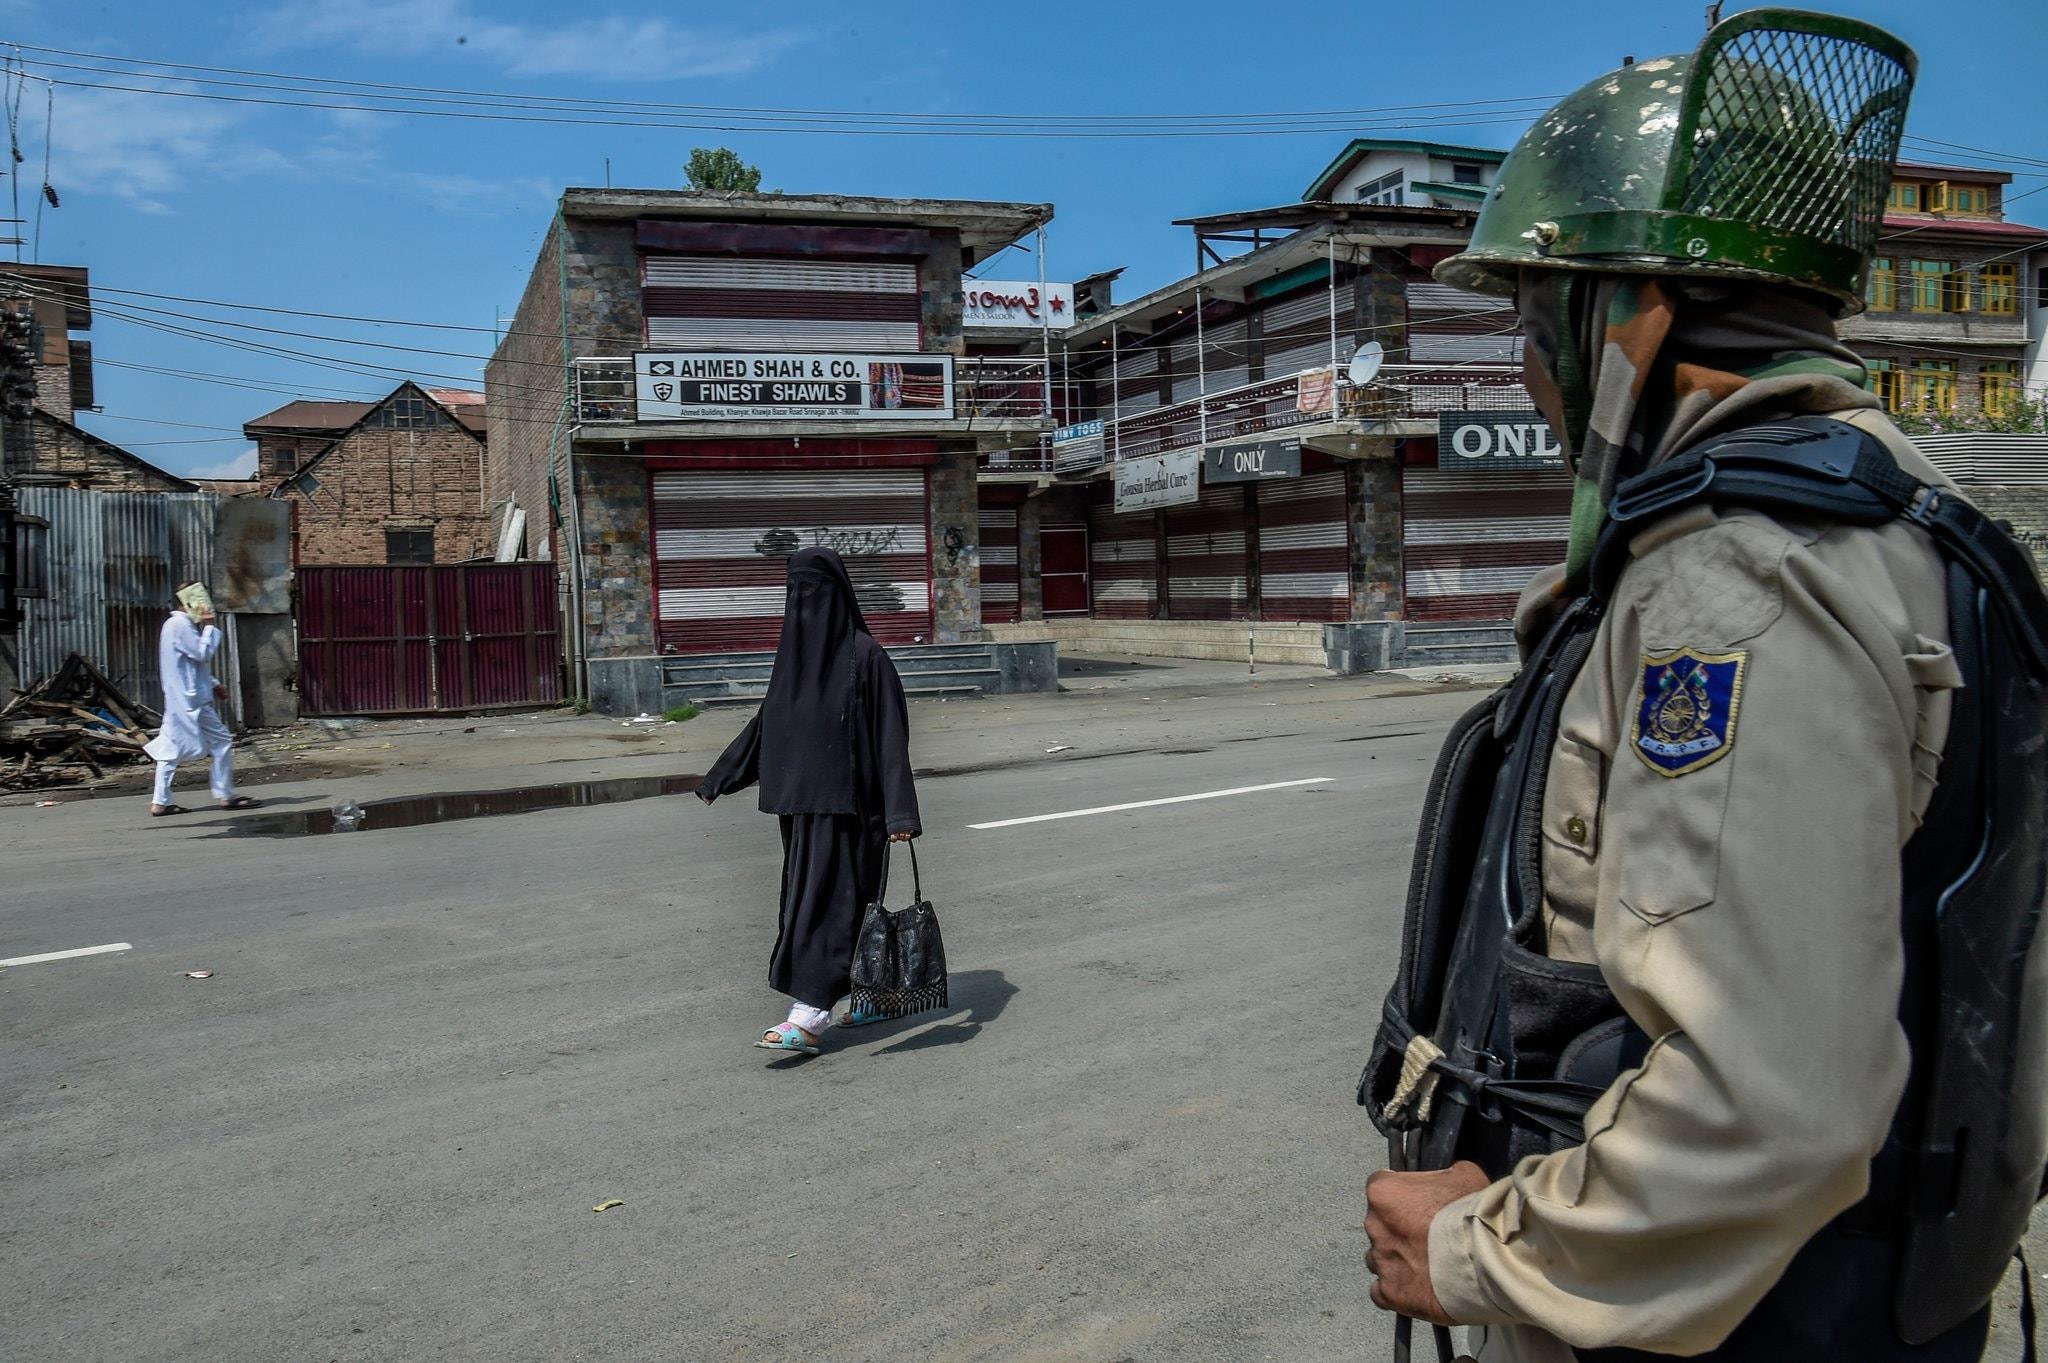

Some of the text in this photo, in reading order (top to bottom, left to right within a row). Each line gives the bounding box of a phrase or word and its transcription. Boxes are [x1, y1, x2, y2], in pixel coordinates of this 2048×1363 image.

[680, 360, 861, 378] AHMED SHAH & CO.
[700, 383, 847, 402] FINEST SHAWLS
[681, 408, 700, 416] Ahmed
[701, 408, 725, 417] Building,
[805, 408, 826, 417] Srinagar
[1077, 421, 1102, 436] TOGS
[1451, 424, 1562, 458] ONL
[1234, 450, 1265, 473] ONLY
[1144, 473, 1168, 493] Herbal
[1169, 472, 1188, 489] Cure
